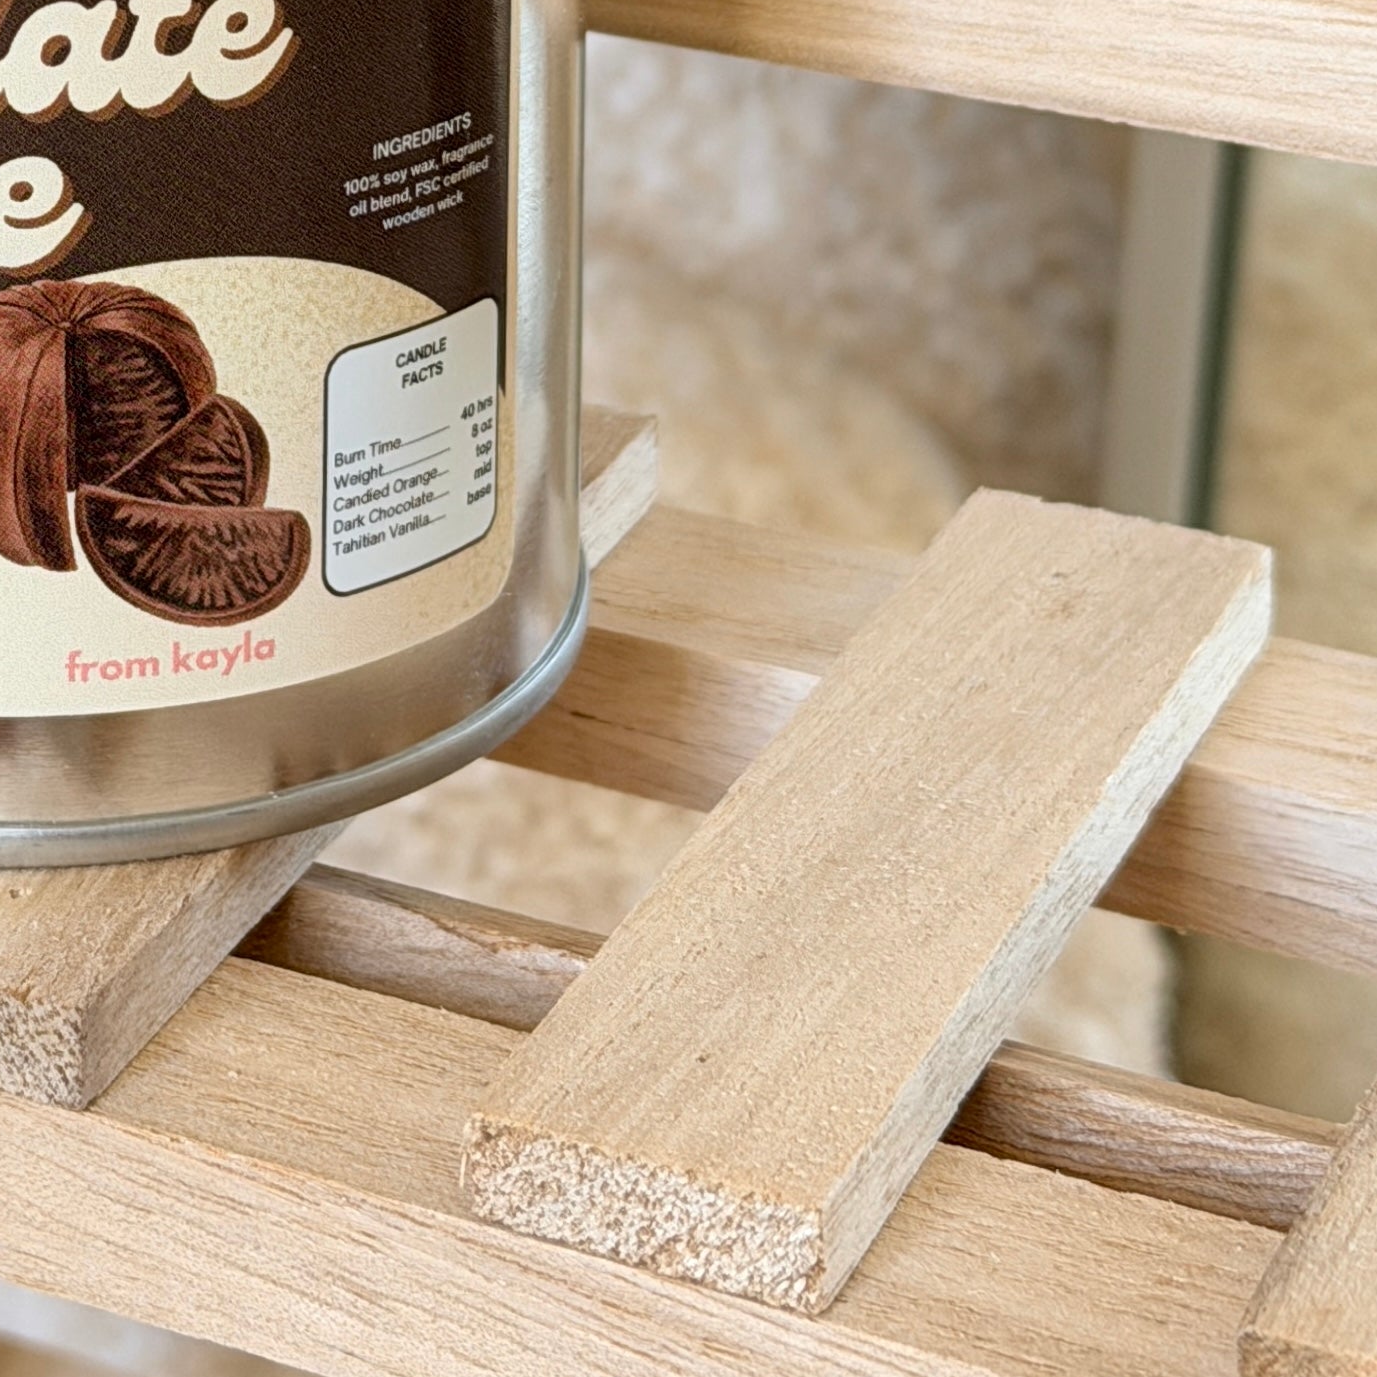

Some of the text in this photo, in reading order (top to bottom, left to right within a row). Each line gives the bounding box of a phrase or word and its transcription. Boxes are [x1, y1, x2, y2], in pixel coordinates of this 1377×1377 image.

[343, 133, 494, 196] 100% soy wax, fragrance
[373, 111, 472, 160] INGREDIENTS
[349, 155, 490, 218] oil blend, FSC certified
[382, 190, 464, 230] wooden wick
[395, 336, 448, 368] CANDLE
[401, 360, 444, 389] FACTS
[333, 417, 492, 490] Weight 8 oz
[334, 449, 366, 468] Burn
[460, 403, 475, 420] 40
[477, 395, 493, 413] hrs
[333, 483, 390, 512] Candied
[476, 440, 492, 457] top
[333, 514, 365, 535] Dark
[474, 457, 492, 480] mid
[332, 530, 386, 556] Tahitian
[467, 482, 492, 505] base
[65, 630, 277, 683] from kayla
